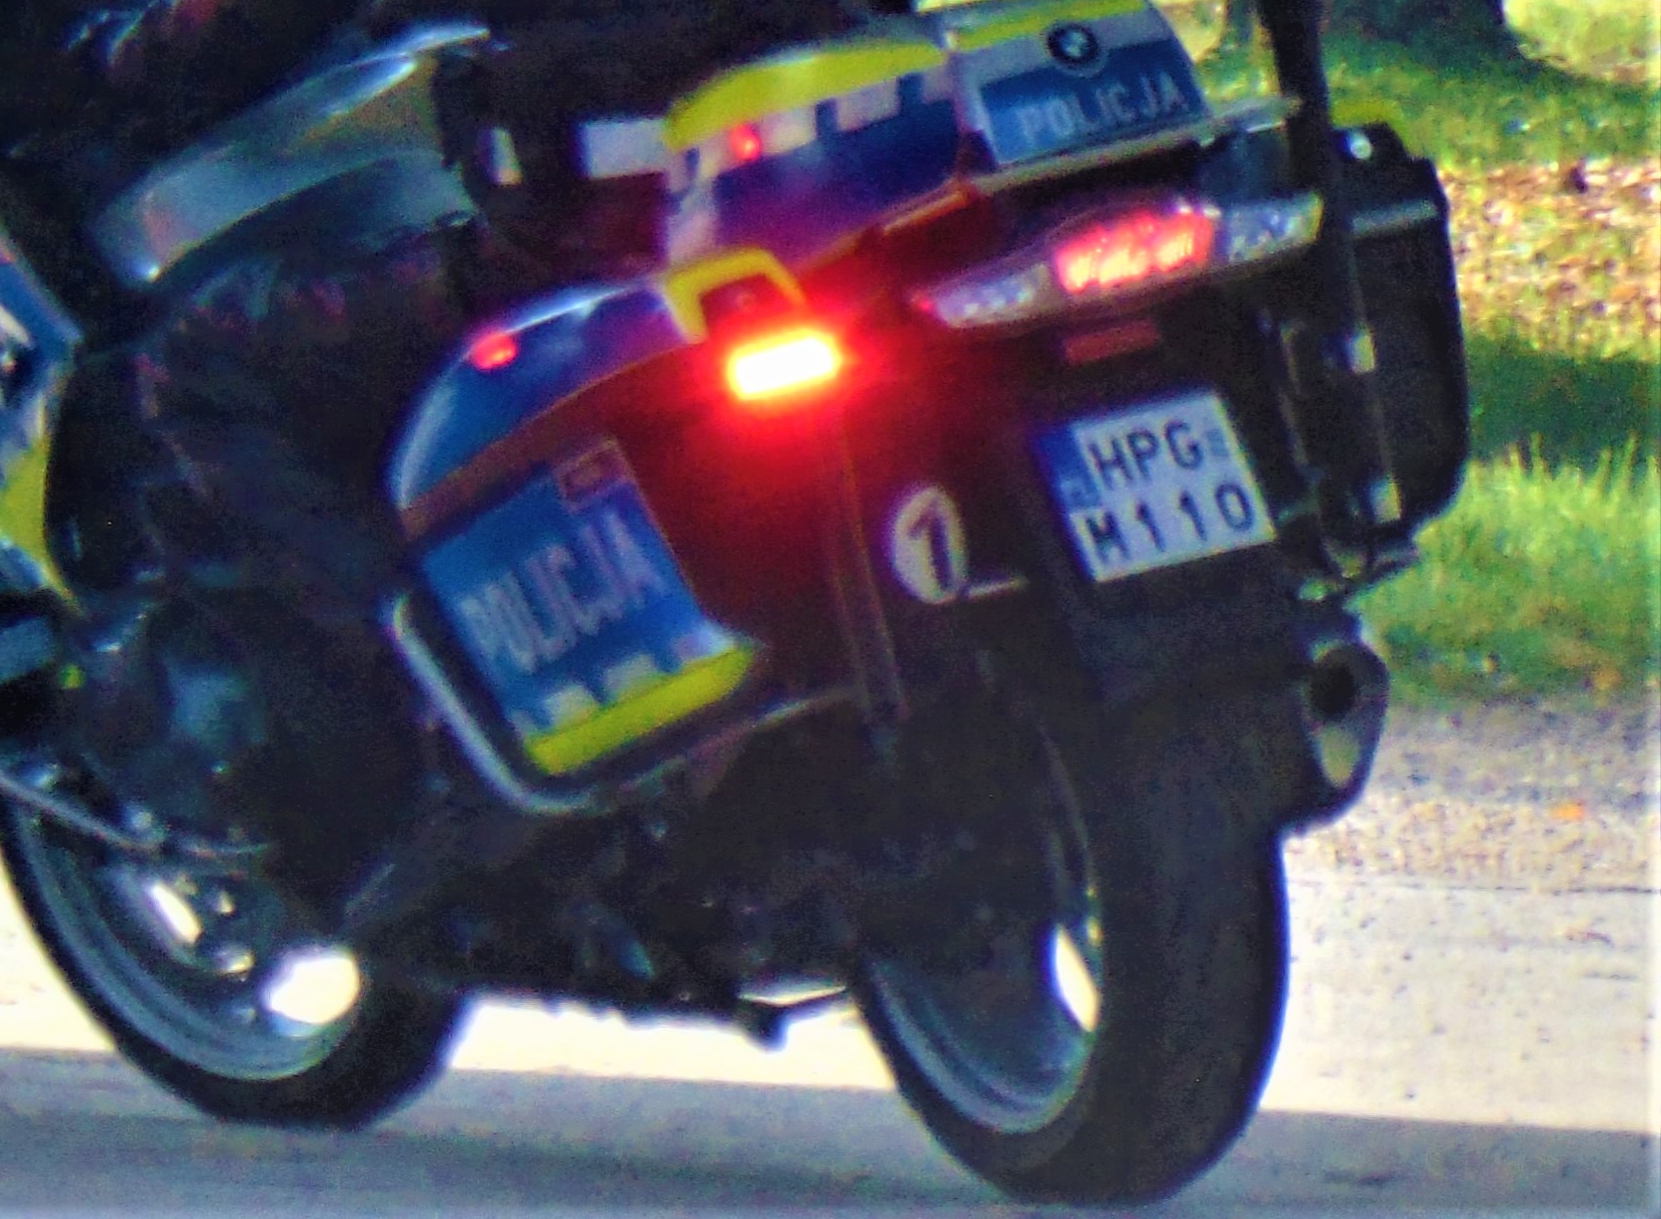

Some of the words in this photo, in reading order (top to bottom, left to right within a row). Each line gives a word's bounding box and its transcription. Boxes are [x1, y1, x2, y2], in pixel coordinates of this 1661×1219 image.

[1016, 71, 1190, 140] POLICJA
[1088, 419, 1205, 491] HPG
[458, 508, 668, 673] POLICJA
